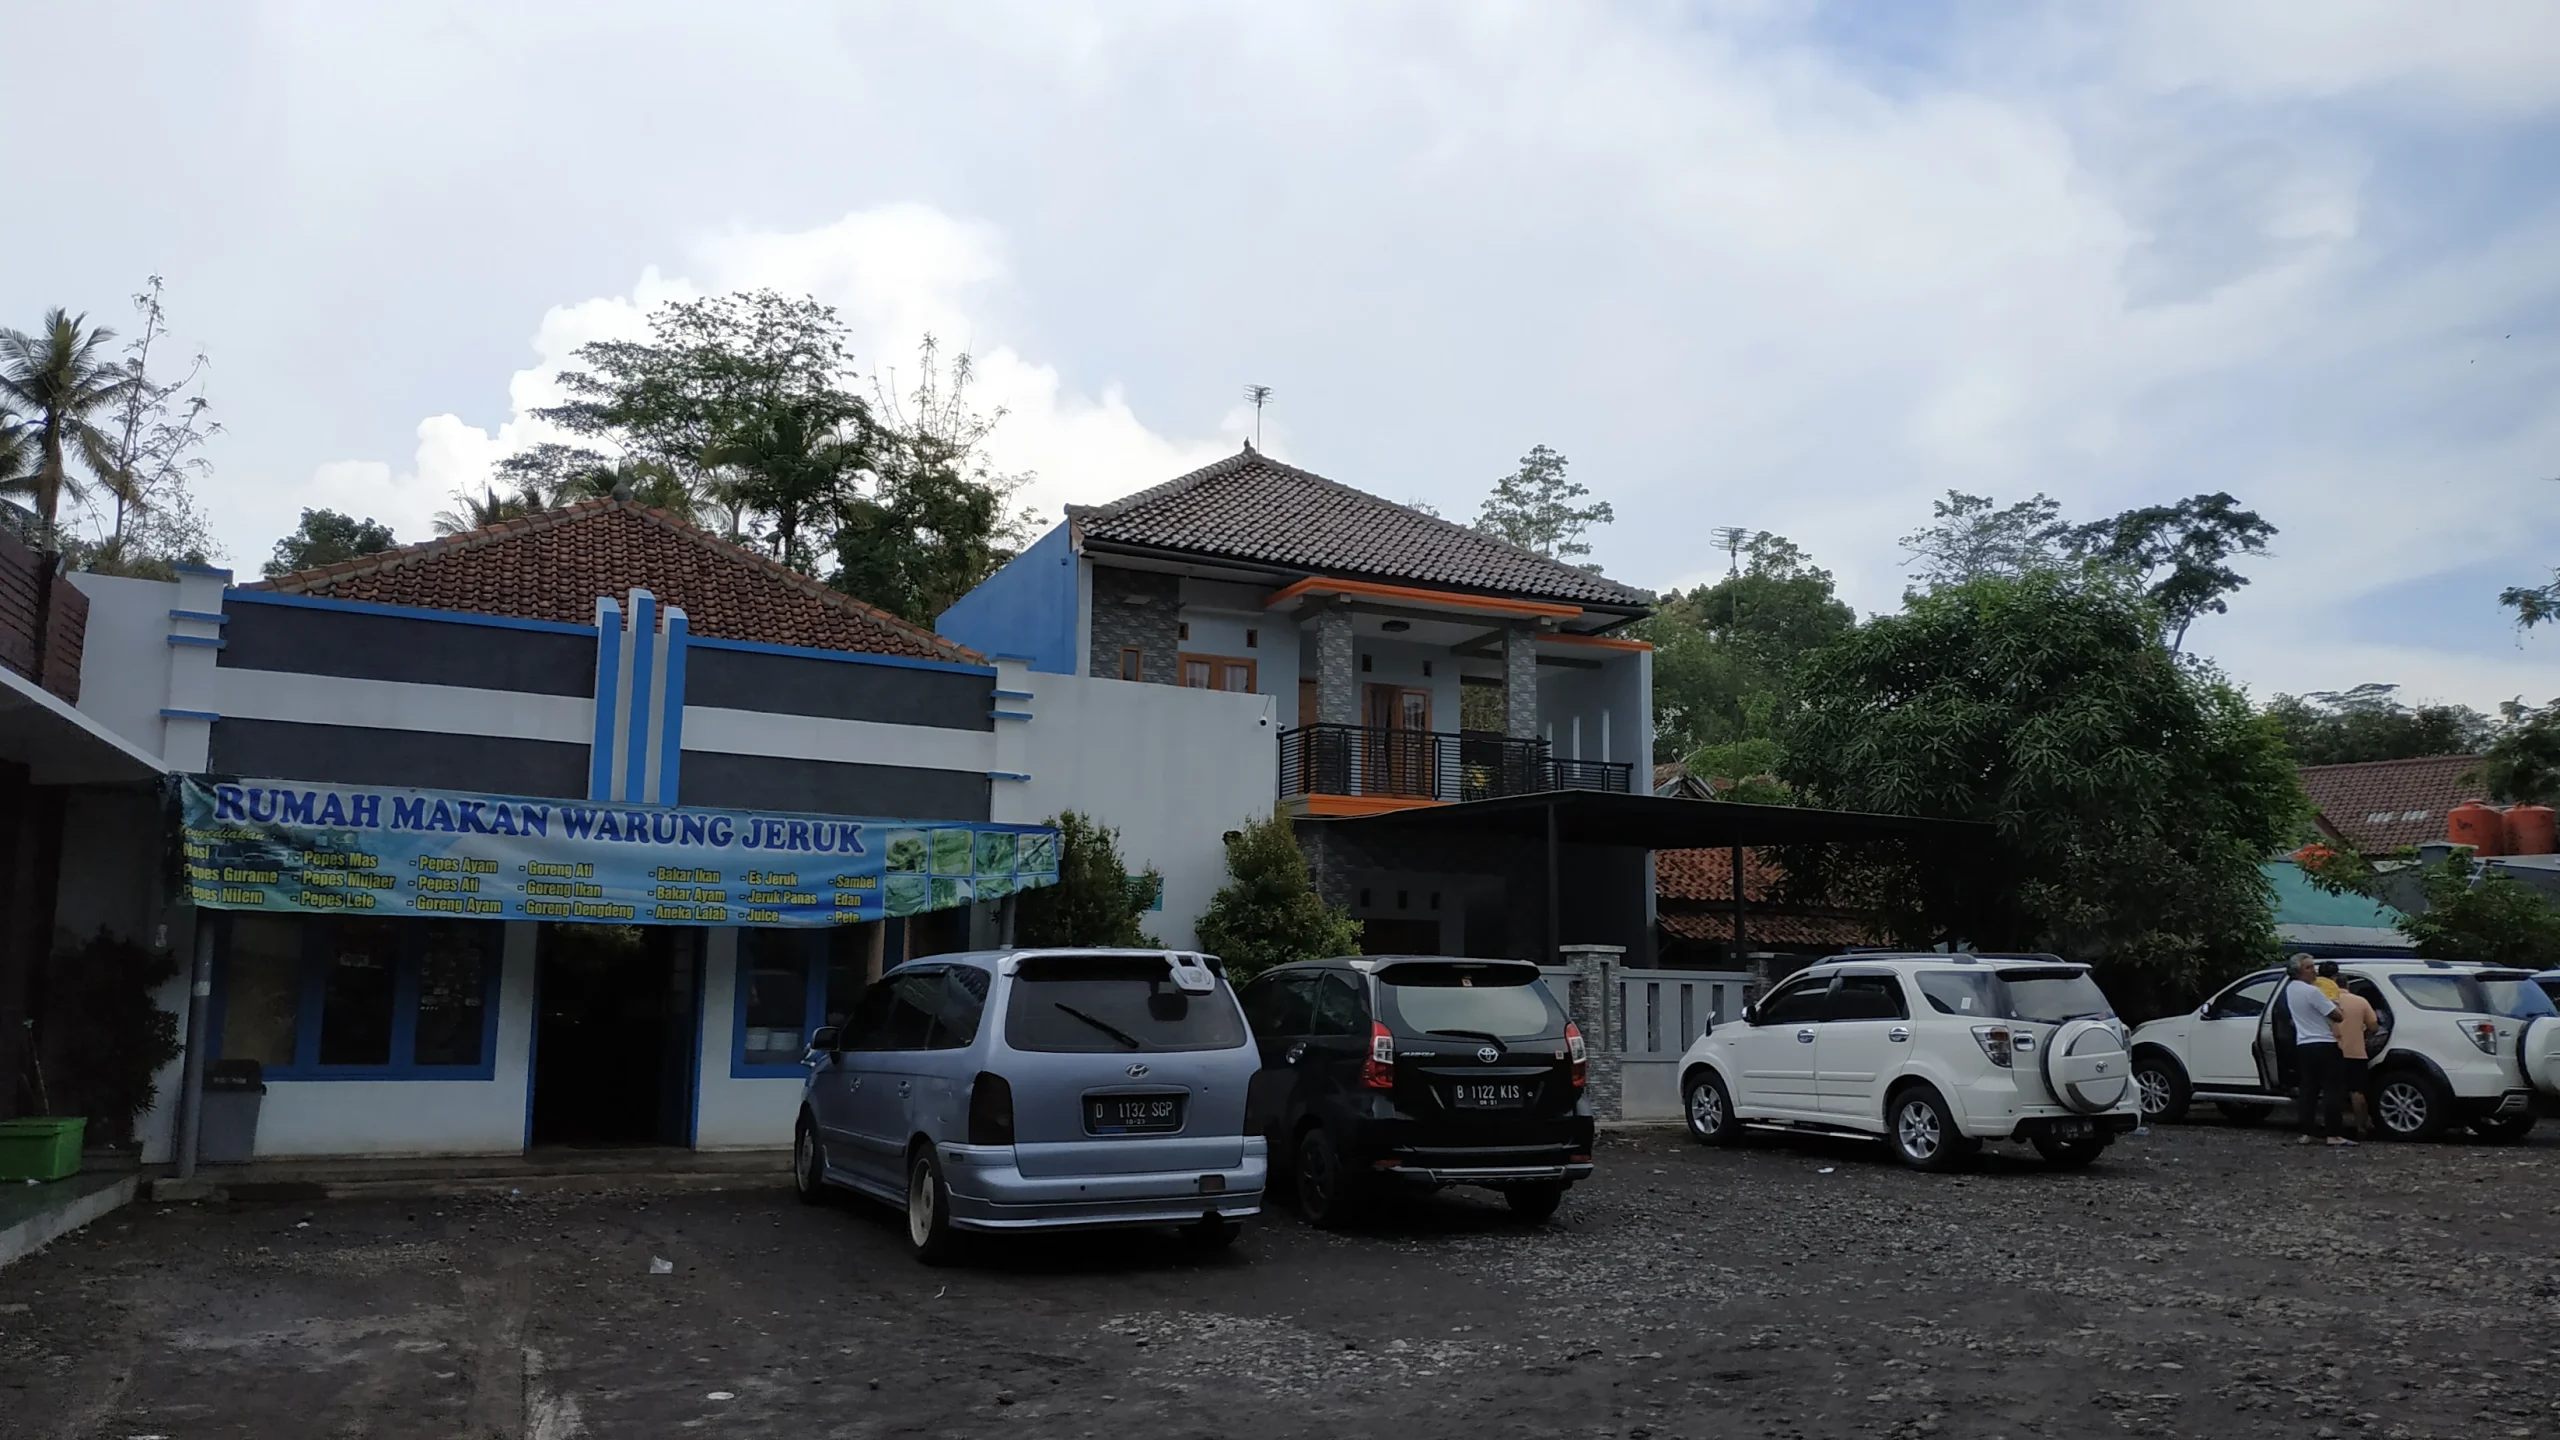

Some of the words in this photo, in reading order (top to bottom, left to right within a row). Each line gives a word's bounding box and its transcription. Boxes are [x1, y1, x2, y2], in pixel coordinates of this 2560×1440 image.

[214, 785, 382, 828] RUMAH
[391, 796, 549, 838] MAKAN
[561, 808, 734, 847] WARUNG
[741, 818, 864, 853] JERUK
[183, 843, 210, 860] Nasi
[303, 850, 345, 867] Pepes
[349, 851, 378, 868] Mas
[184, 863, 220, 883] Pepes
[223, 866, 279, 884] Gurame
[419, 855, 459, 873] Pepes
[461, 857, 498, 874] Ayam
[528, 861, 573, 878] Goreng
[575, 862, 593, 878] Ati
[302, 870, 344, 888] Pepes
[347, 871, 395, 890] Mujaer
[417, 875, 458, 893] Pepes
[460, 877, 480, 893] Ati
[657, 866, 692, 882] Bakar
[694, 868, 720, 884] Ikan
[748, 871, 762, 886] Es
[764, 872, 798, 887] Jeruk
[836, 874, 877, 890] Sambel
[183, 884, 218, 903] Pepes
[221, 887, 264, 904] Nilem
[526, 880, 572, 898] Goreng
[575, 883, 602, 898] Ikan
[656, 886, 691, 901] Bakar
[693, 887, 726, 903] Ayam
[747, 889, 781, 904] Jeruk
[783, 890, 817, 905] Panas
[300, 890, 343, 908] Pepes
[345, 892, 375, 908] Lele
[416, 895, 463, 914] Goreng
[465, 897, 502, 914] Ayam
[834, 892, 861, 907] Edan
[525, 899, 571, 917] Goreng
[573, 901, 635, 920] Dengdeng
[655, 904, 692, 920] Aneka
[694, 905, 727, 921] Lalab
[747, 908, 779, 923] Juice
[835, 911, 860, 924] Pete
[1456, 1084, 1464, 1099] B
[1471, 1084, 1495, 1099] 1122
[1500, 1084, 1520, 1099] KIS
[1096, 1103, 1104, 1119] D
[1118, 1102, 1146, 1118] 1132
[1151, 1101, 1173, 1117] SGP
